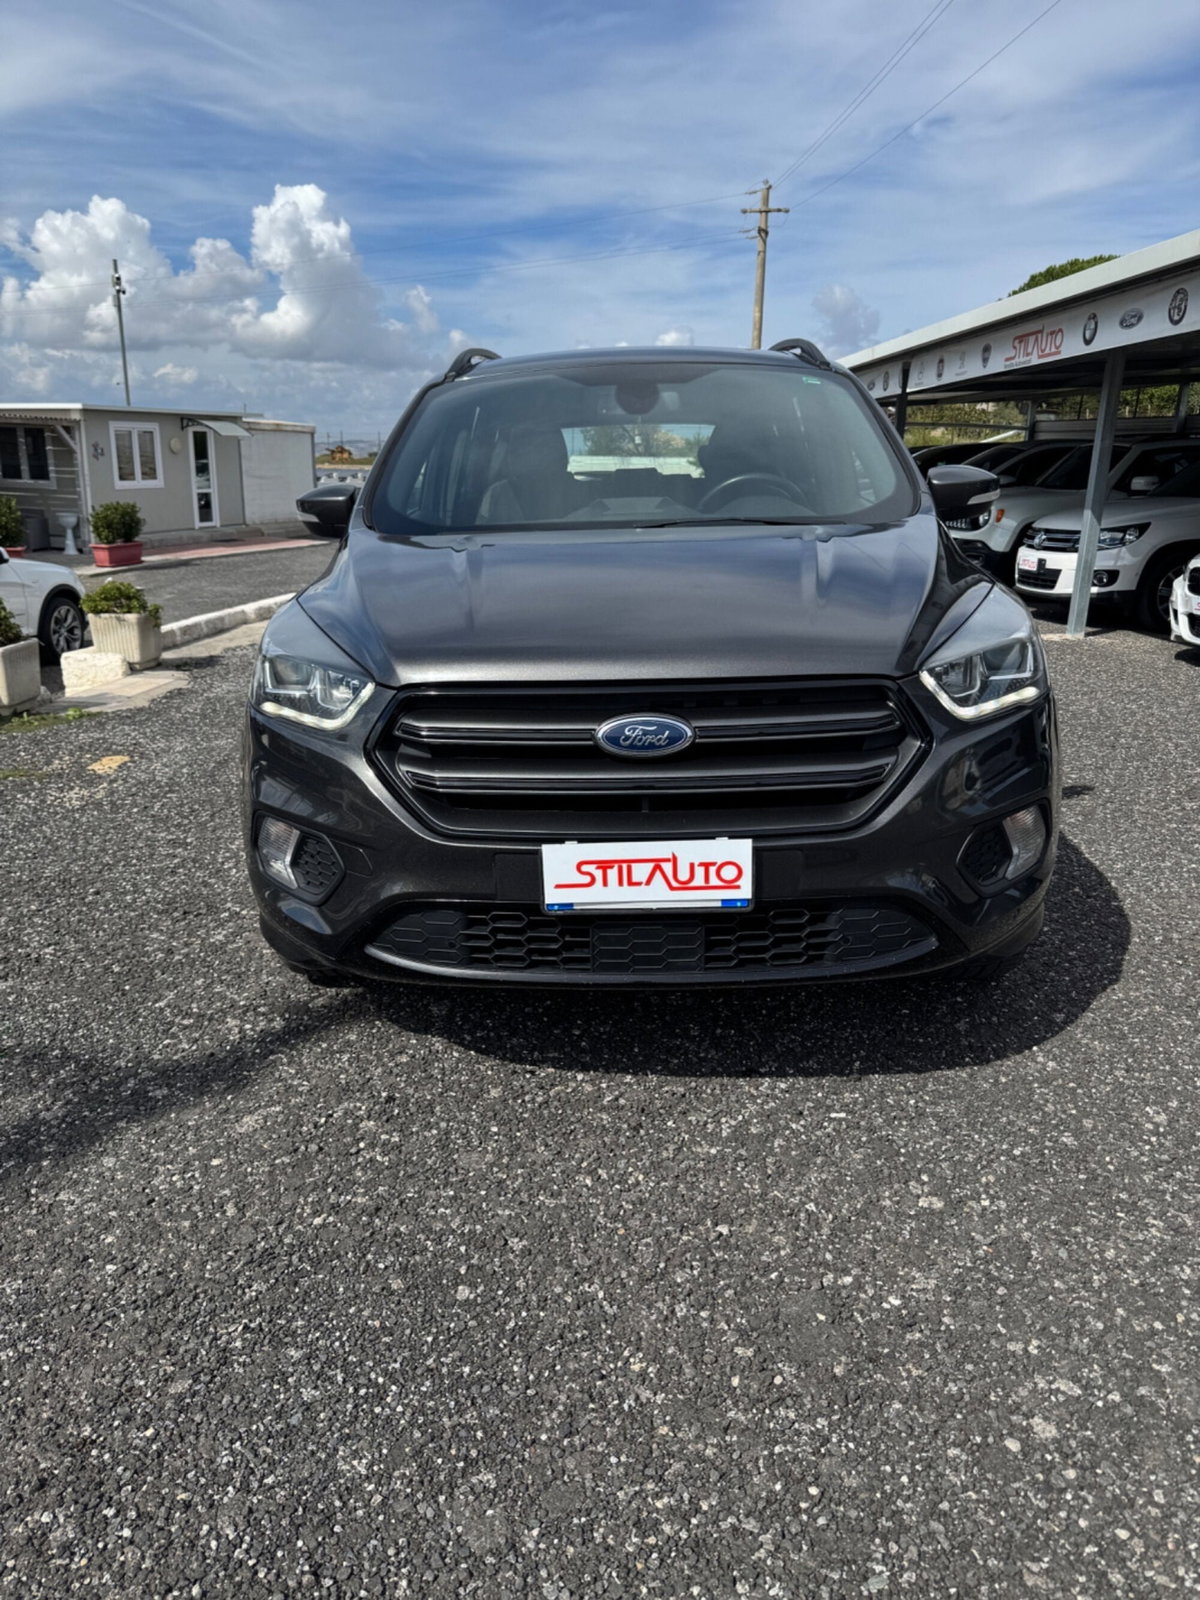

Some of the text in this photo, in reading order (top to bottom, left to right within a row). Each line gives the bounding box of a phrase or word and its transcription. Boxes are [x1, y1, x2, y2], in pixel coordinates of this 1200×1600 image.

[1004, 324, 1064, 362] STILAUTO
[619, 725, 669, 746] Ford
[553, 851, 743, 892] STILAUTO
